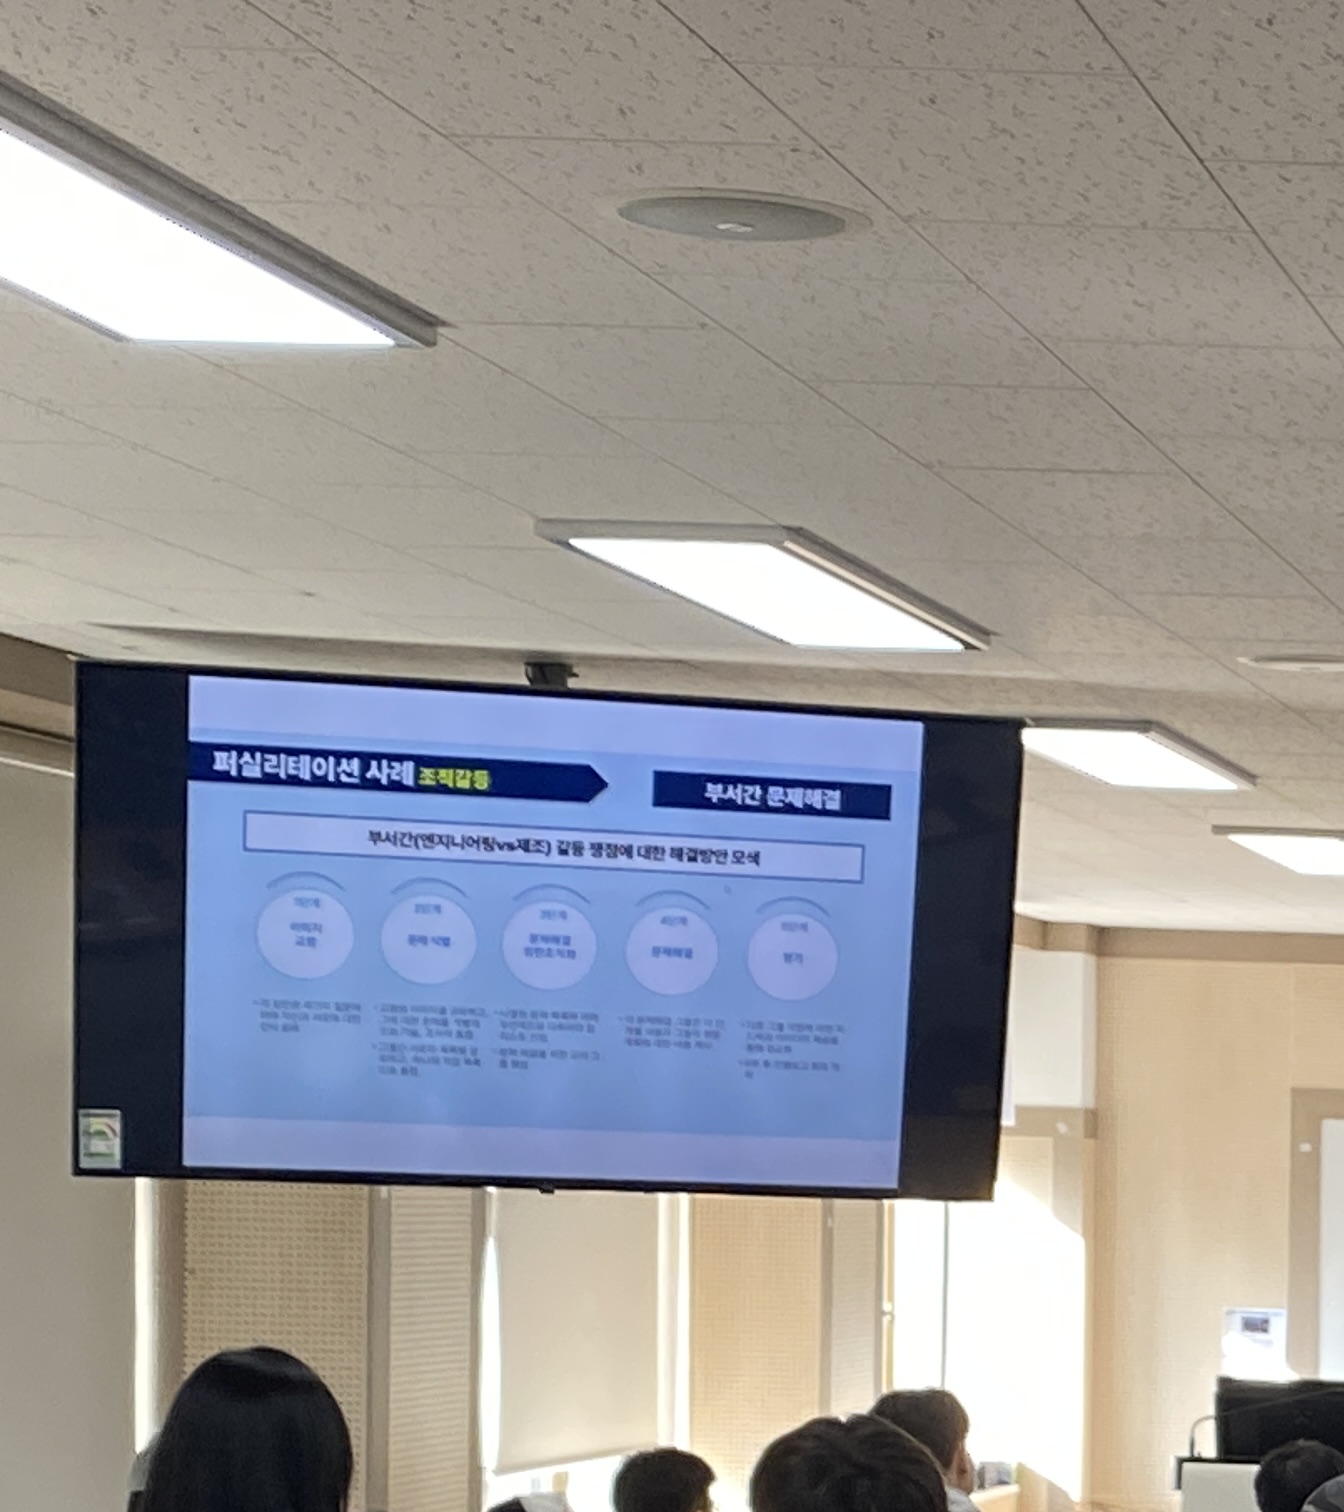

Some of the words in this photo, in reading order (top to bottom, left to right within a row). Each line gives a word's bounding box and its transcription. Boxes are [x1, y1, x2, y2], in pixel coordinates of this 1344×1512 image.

[213, 750, 361, 783] 퍼실리테이션
[365, 759, 415, 787] 사례
[418, 766, 491, 790] 조직갈등
[704, 782, 761, 806] 부서간
[766, 785, 842, 811] 문제해결
[637, 844, 666, 863] 대한
[669, 846, 730, 866] 해결방안
[731, 848, 761, 868] 모색
